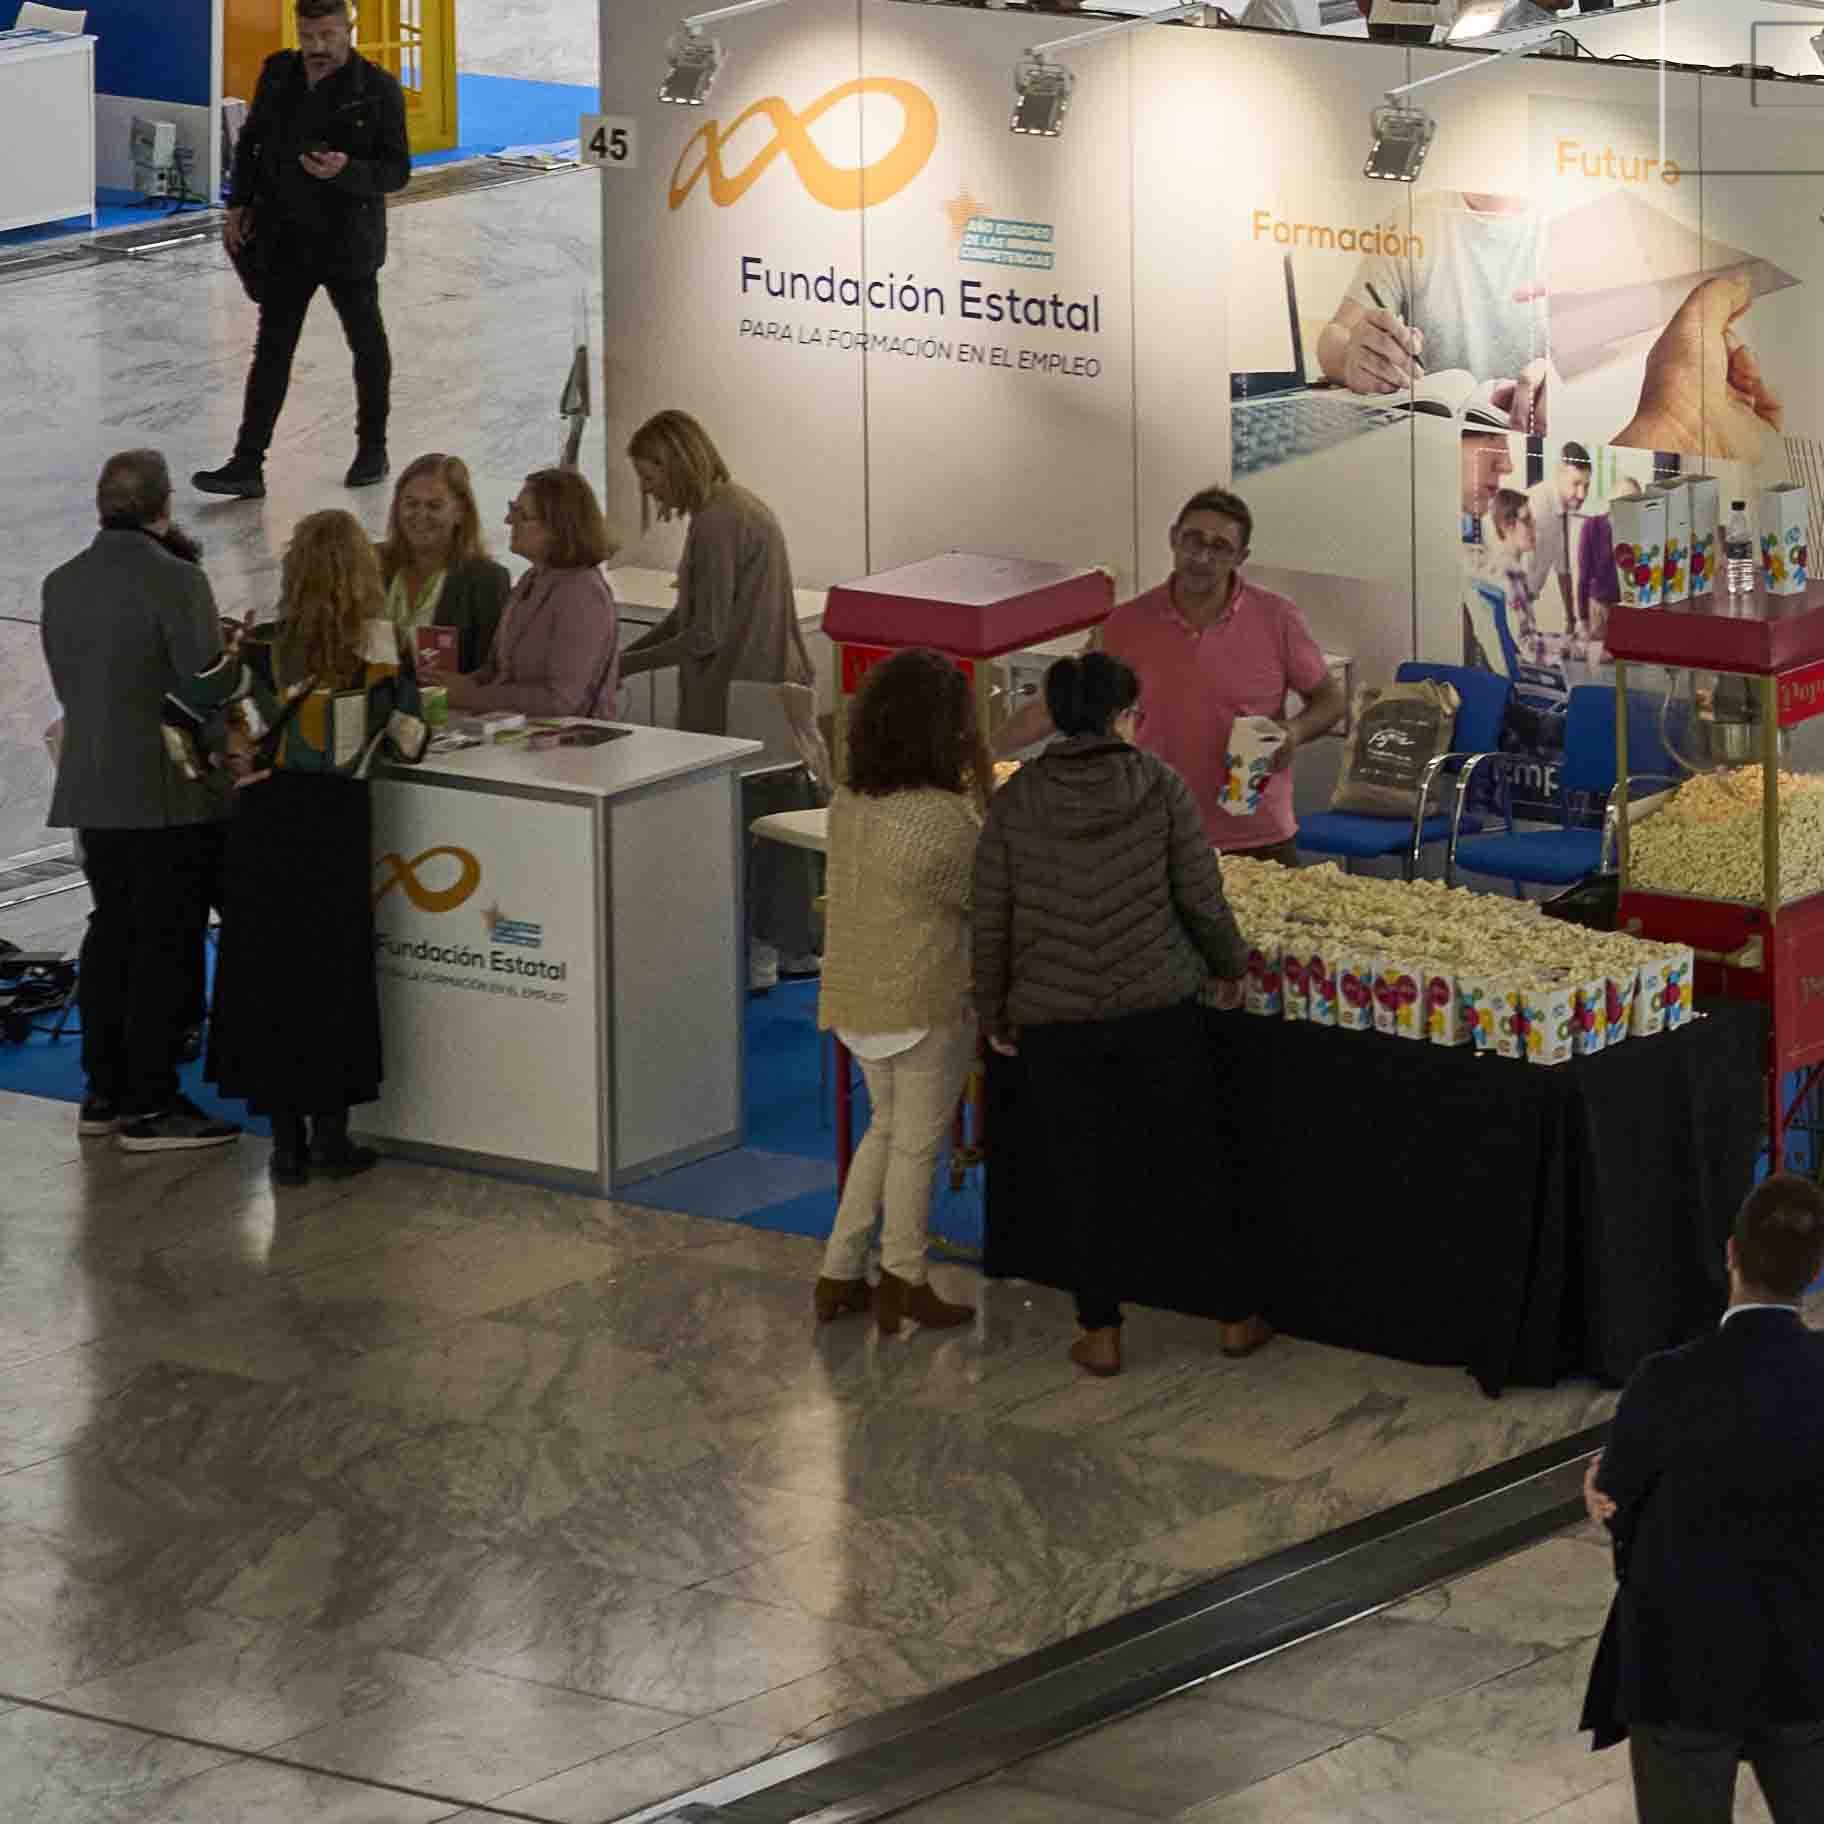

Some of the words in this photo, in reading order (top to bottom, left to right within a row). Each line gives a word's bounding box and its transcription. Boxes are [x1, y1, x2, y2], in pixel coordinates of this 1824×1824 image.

[588, 126, 629, 161] 45
[1555, 139, 1682, 186] Futuro
[1251, 208, 1425, 260] Formación
[740, 255, 945, 317] Fundación
[959, 279, 1102, 334] Estatal
[739, 318, 793, 345] PARA
[798, 326, 824, 347] LA
[826, 328, 953, 363] FORMACIÓN
[957, 344, 987, 366] EN
[990, 346, 1014, 369] EL
[1017, 351, 1102, 380] EMPLEO
[489, 950, 567, 982] Estatal
